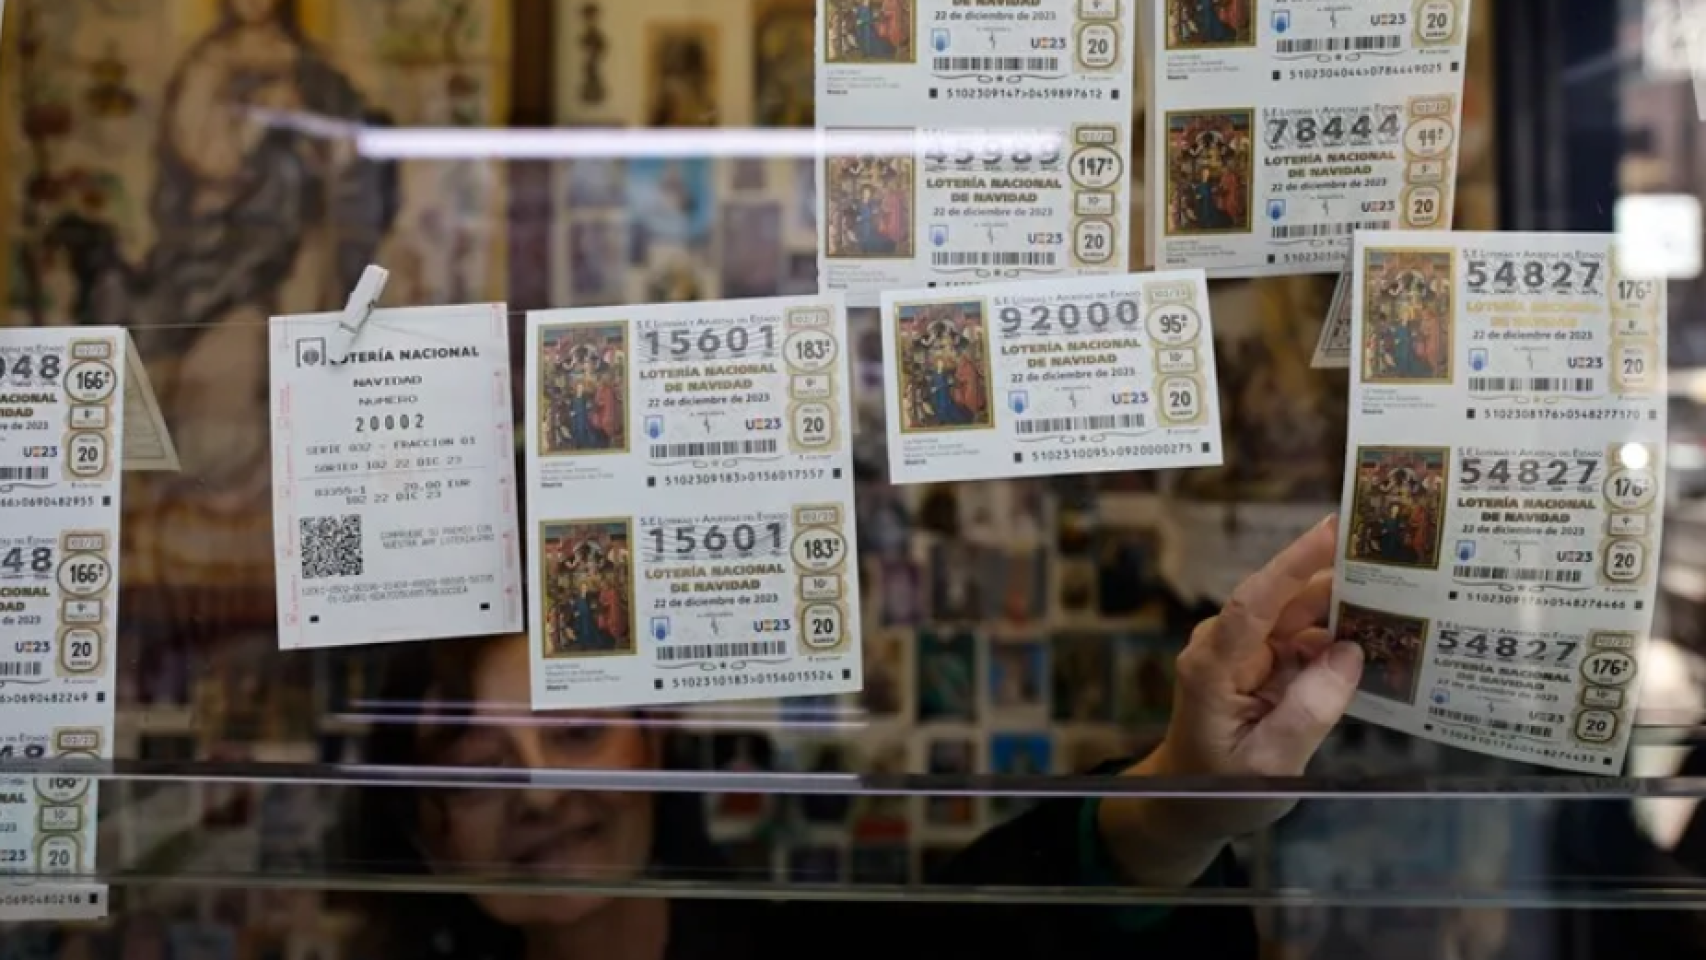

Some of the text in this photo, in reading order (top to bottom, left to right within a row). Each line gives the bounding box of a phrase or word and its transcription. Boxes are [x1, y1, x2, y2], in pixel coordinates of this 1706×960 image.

[935, 10, 1056, 21] 22 de diciembre de 2023
[1427, 13, 1447, 29] 20
[1087, 38, 1108, 54] 20
[1268, 114, 1400, 144] 78444
[1264, 151, 1396, 166] LOTERÍA NACIONAL
[1288, 165, 1372, 178] DE NAVIDAD
[926, 176, 1062, 188] LOTERÍA NACIONAL
[1272, 178, 1388, 192] 22 de diciembre de 2023
[950, 192, 1038, 202] DE NAVIDAD
[933, 206, 1053, 217] 22 de diciembre de 2023
[1414, 200, 1434, 214] 20
[1084, 234, 1104, 250] 20
[1467, 261, 1600, 288] 54827
[999, 300, 1140, 332] 92000
[644, 326, 774, 355] 15601
[1472, 330, 1593, 340] 22 de diciembre de 2023
[1001, 338, 1141, 355] LOTERÍA NACIONAL
[330, 346, 480, 365] TERÍA NACIONAL
[1028, 354, 1118, 368] DE NAVIDAD
[640, 364, 778, 380] LOTERÍA NACIONAL
[1624, 358, 1644, 375] 20
[353, 375, 423, 388] NAVIDAD
[1010, 368, 1136, 384] 22 de diciembre de 2023
[664, 379, 753, 393] DE NAVIDAD
[358, 394, 419, 406] NUMERO
[648, 392, 770, 408] 22 de diciembre de 2023
[1169, 392, 1192, 408] 20
[26, 421, 48, 430] 2023
[355, 412, 425, 432] 20002
[803, 418, 825, 434] 20
[306, 443, 341, 455] SERIE
[394, 436, 454, 450] FRACCION
[78, 448, 98, 463] 20
[315, 463, 358, 473] SORTEO
[416, 456, 440, 467] DIC
[1460, 458, 1598, 486] 54827
[1456, 496, 1596, 510] LOTERÍA NACIONAL
[1480, 512, 1570, 523] DE NAVIDAD
[649, 522, 781, 554] 15601
[1462, 525, 1585, 536] 22 de diciembre de 2023
[1614, 553, 1635, 568] 20
[645, 563, 786, 580] LOTERÍA NACIONAL
[670, 580, 761, 594] DE NAVIDAD
[654, 594, 778, 608] 22 de diciembre de 2023
[18, 615, 41, 625] 2023
[812, 619, 834, 634] 20
[71, 642, 92, 657] 20
[1438, 630, 1578, 661] 54827
[1434, 657, 1572, 684] LOTERÍA NACIONAL
[1456, 672, 1545, 690] DE NAVIDAD
[1586, 720, 1606, 732] 20
[49, 850, 69, 866] 20
